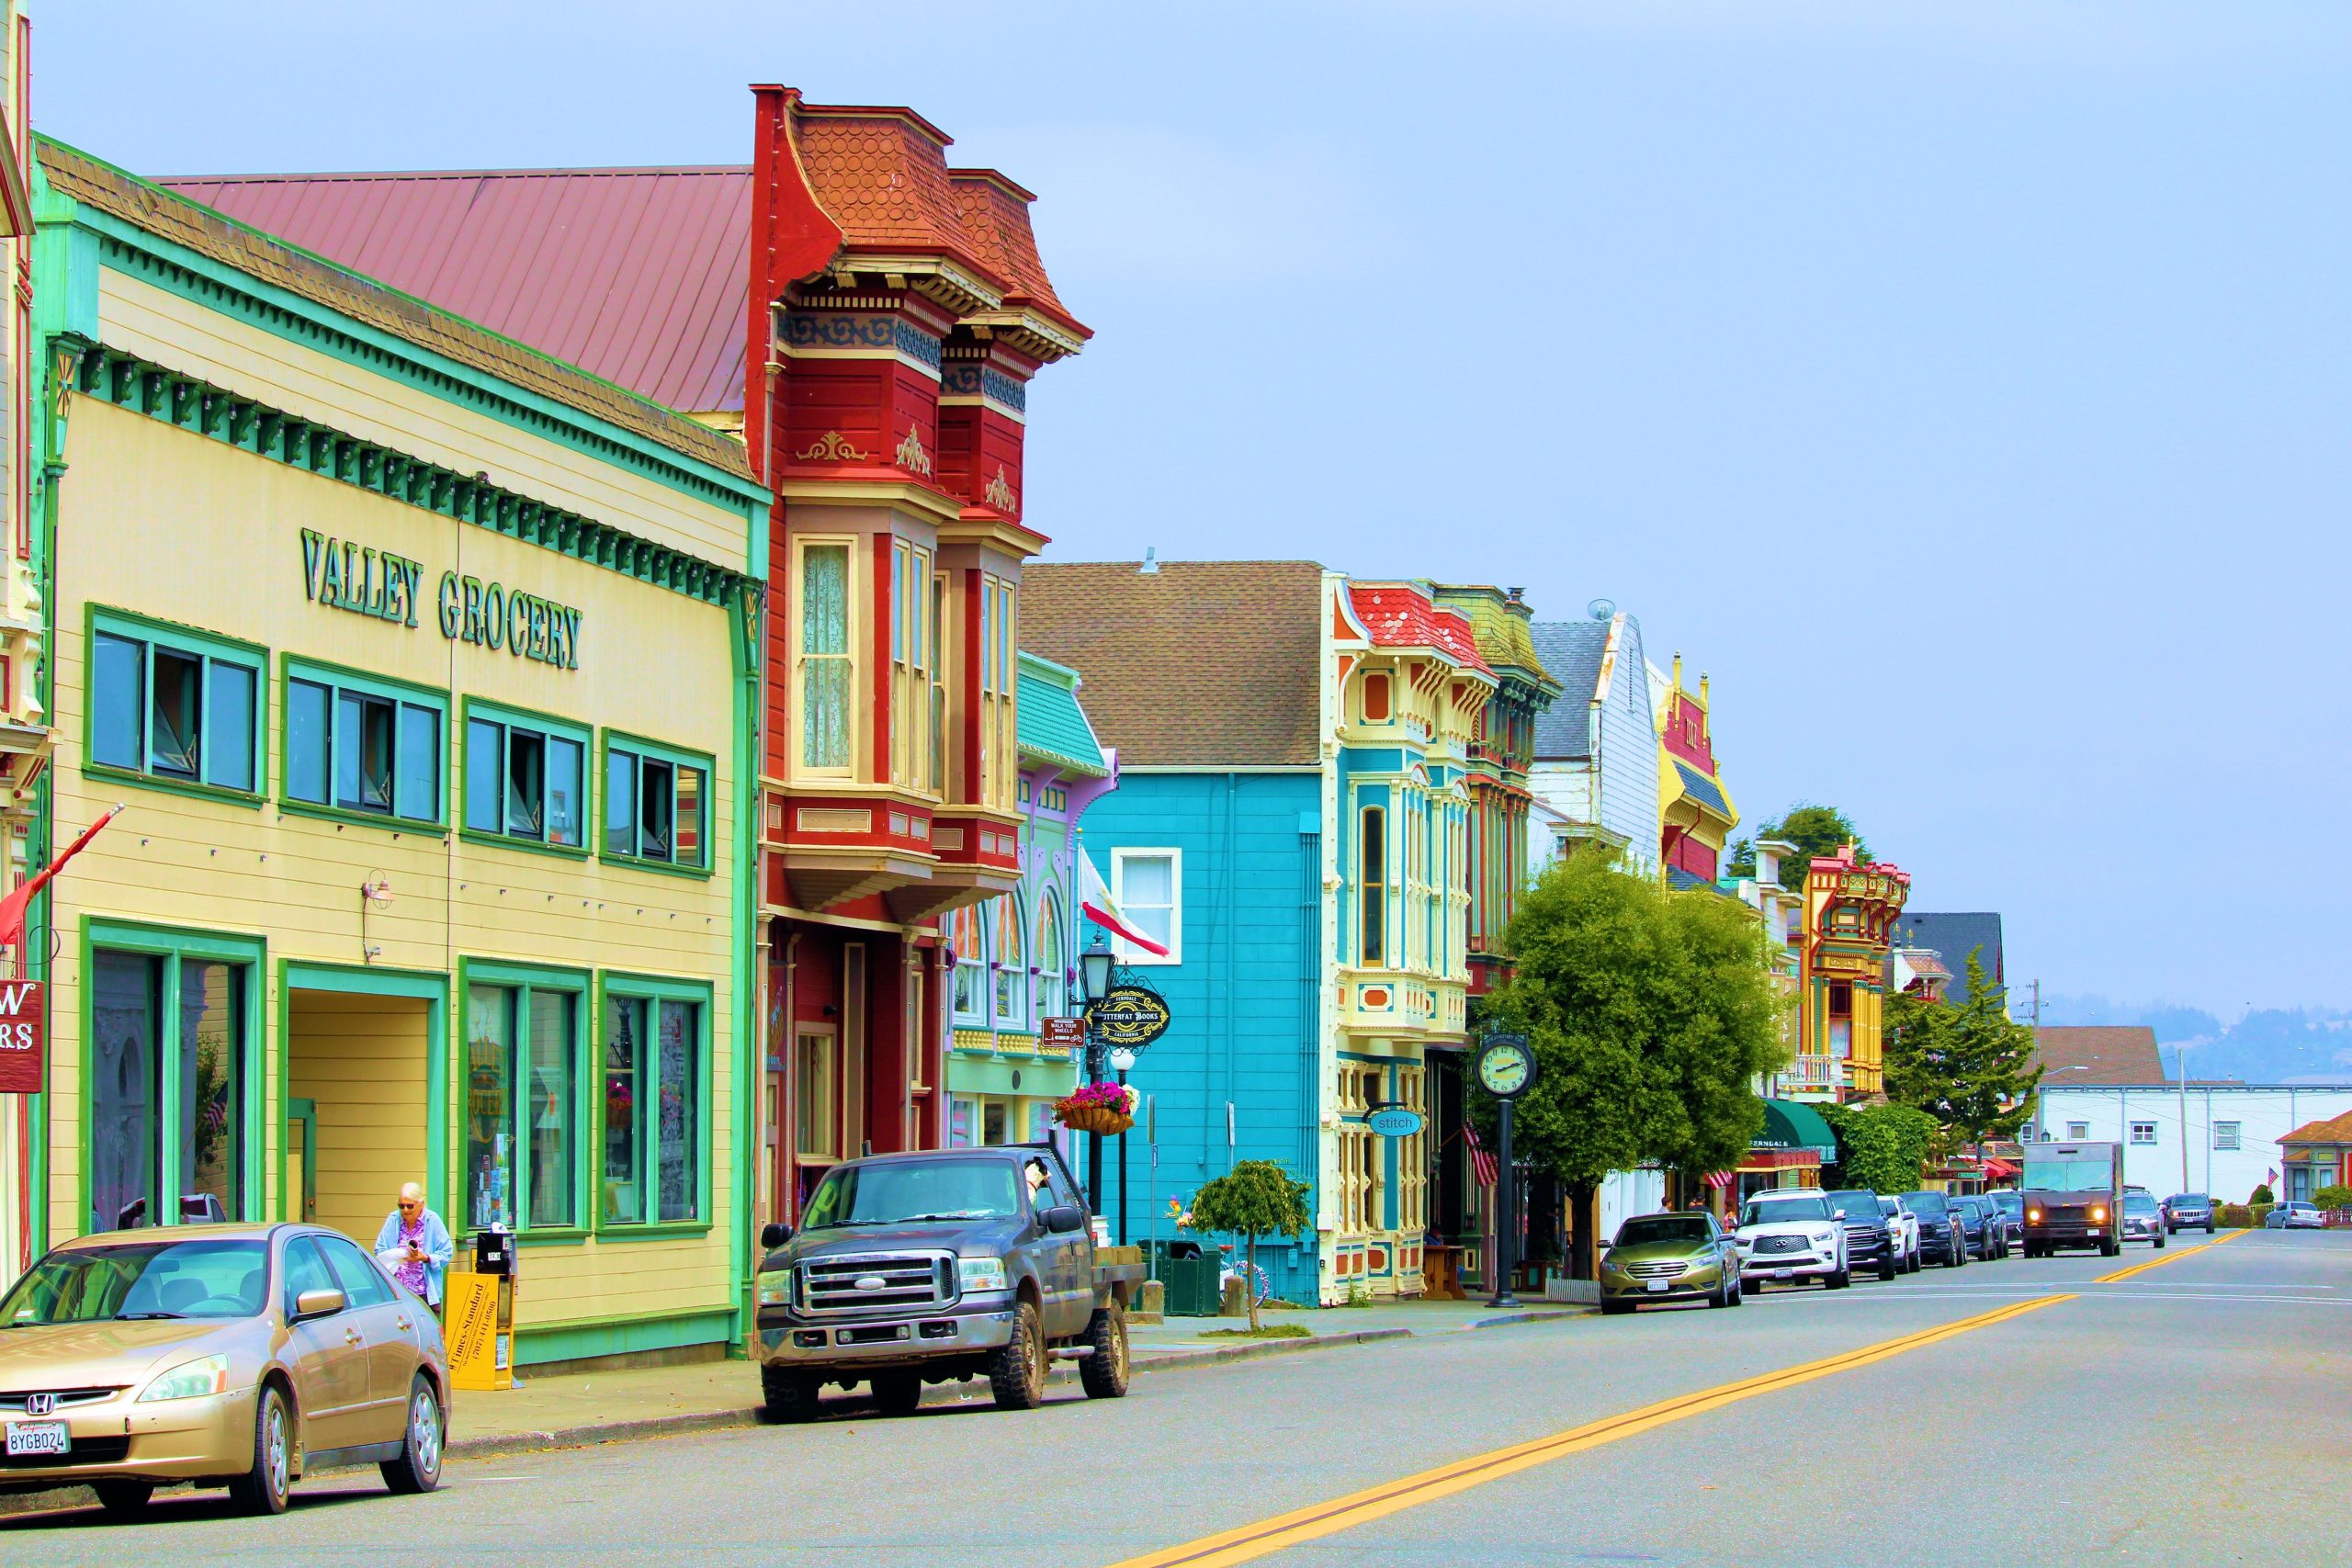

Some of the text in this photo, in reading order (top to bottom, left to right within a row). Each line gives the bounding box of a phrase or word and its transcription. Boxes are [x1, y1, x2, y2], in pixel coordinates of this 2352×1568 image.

[301, 526, 583, 671] VALLEY GROCERY
[1378, 1116, 1413, 1129] stitch
[451, 1283, 484, 1363] Times-Standard
[472, 1301, 496, 1359] (707) 441-0500
[11, 1433, 64, 1449] 8YGB024
